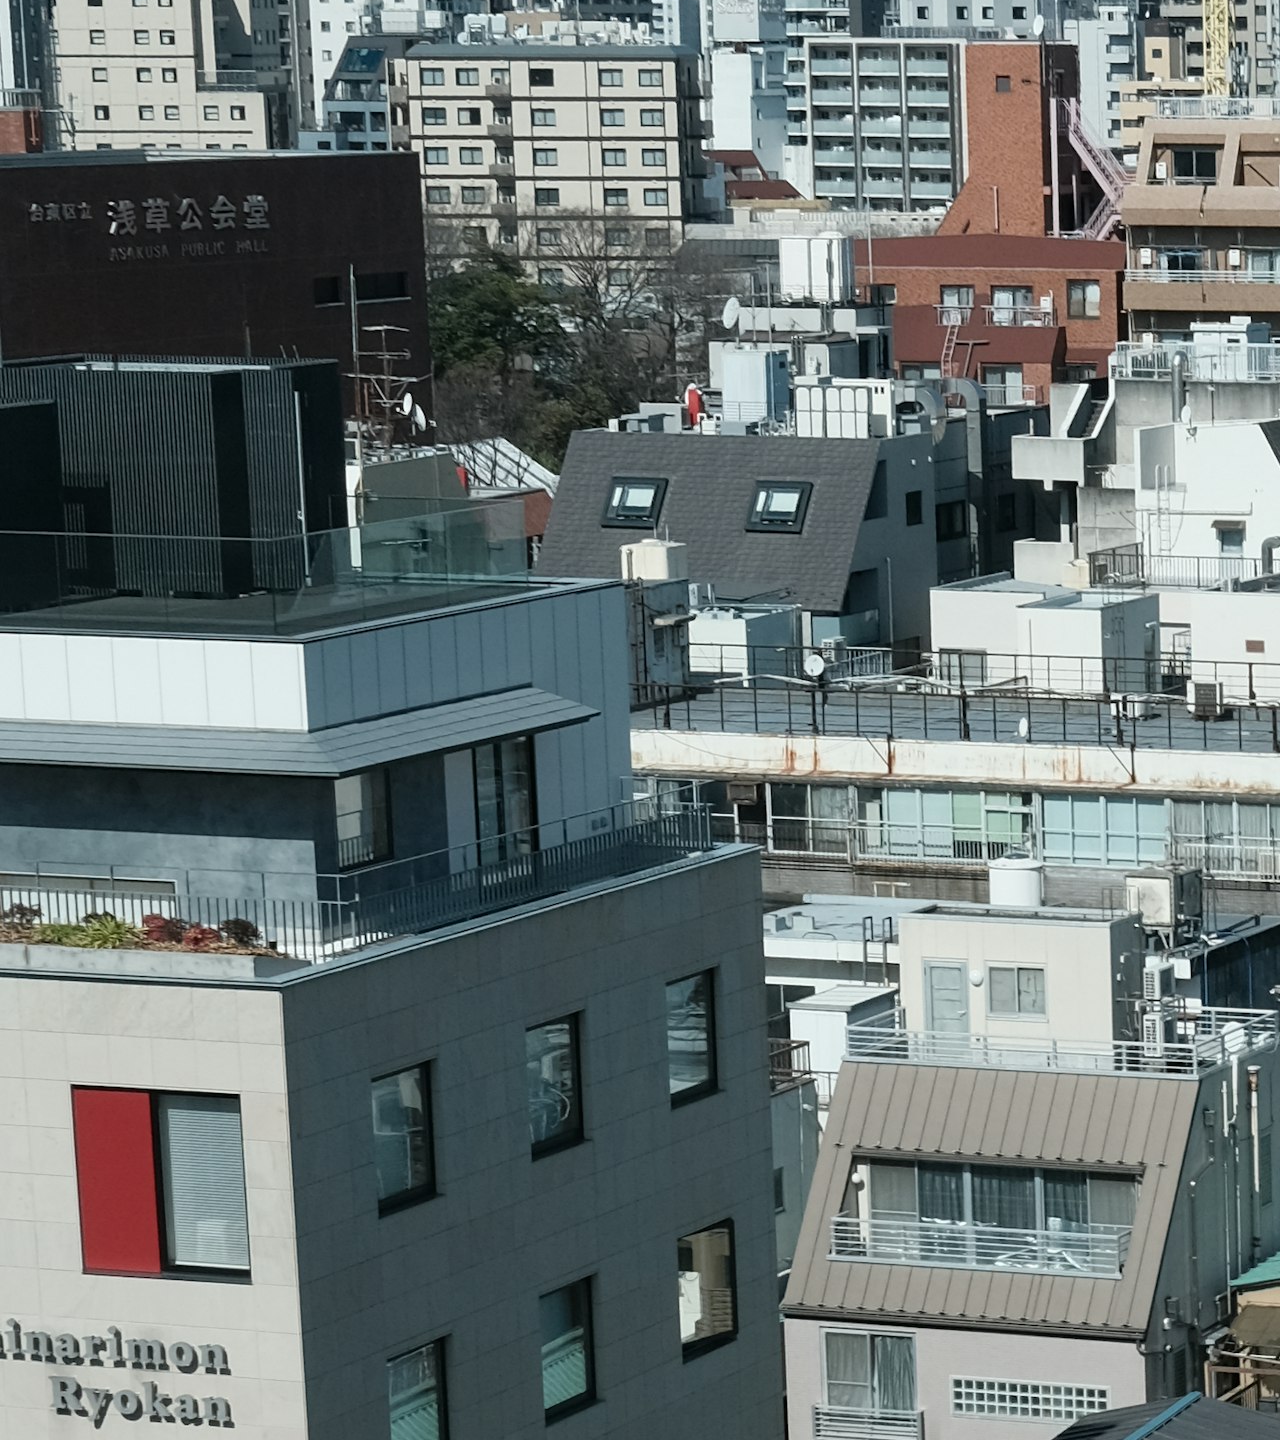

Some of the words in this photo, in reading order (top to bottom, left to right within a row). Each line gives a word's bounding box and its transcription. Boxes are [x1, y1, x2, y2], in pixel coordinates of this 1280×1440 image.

[107, 195, 270, 236] 浅草公会堂
[110, 245, 169, 261] ASAKUSA
[181, 241, 225, 257] PUBLIC
[236, 240, 268, 253] HALL
[0, 1318, 231, 1374] inarimon
[49, 1376, 233, 1427] Ryokan
